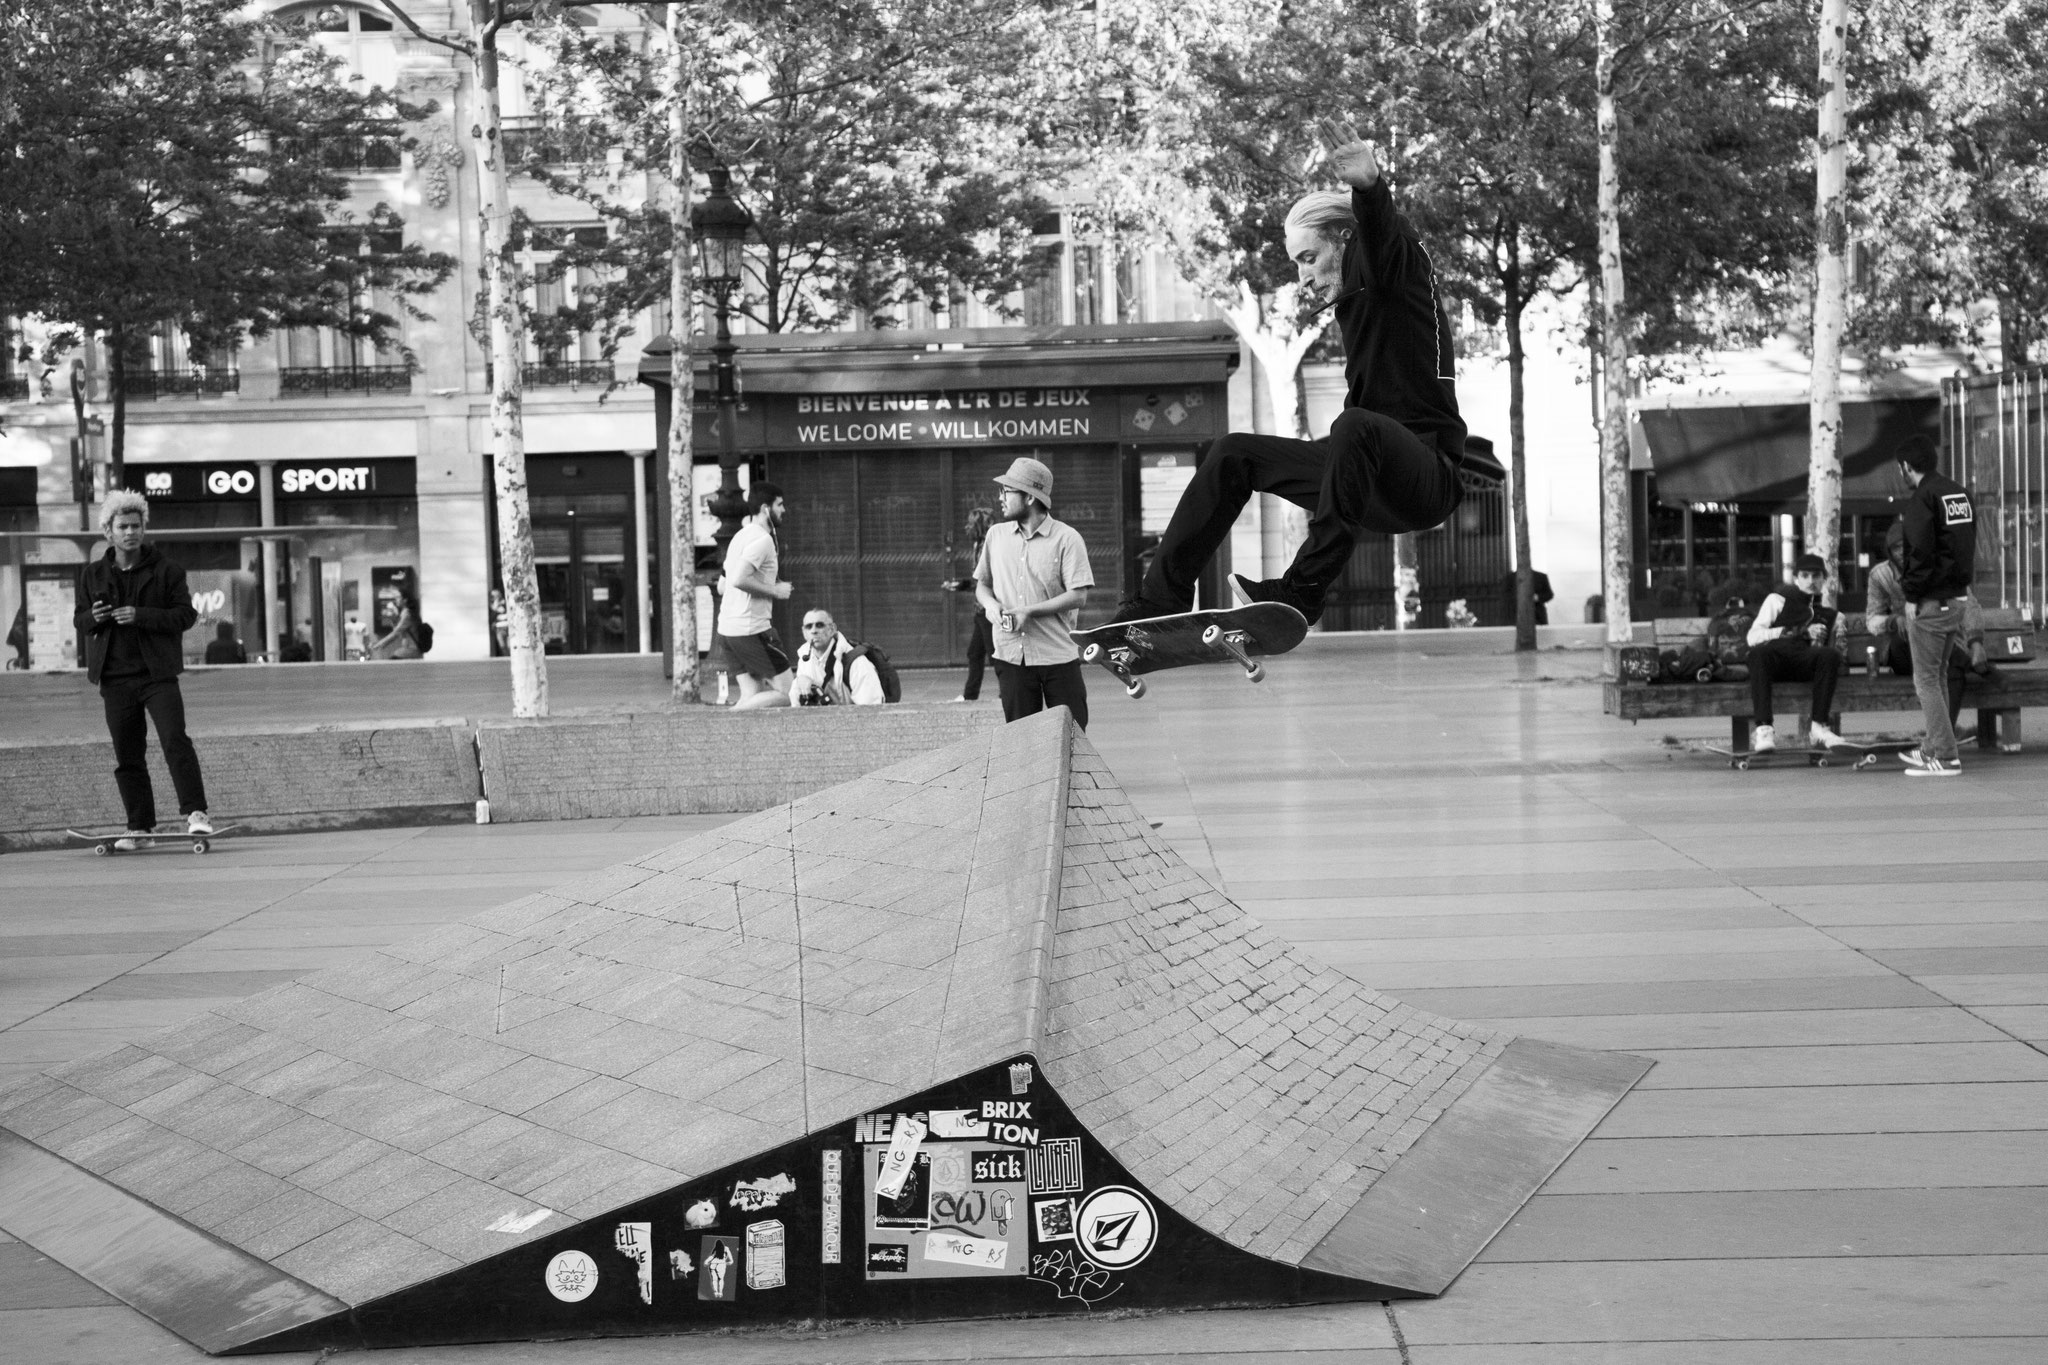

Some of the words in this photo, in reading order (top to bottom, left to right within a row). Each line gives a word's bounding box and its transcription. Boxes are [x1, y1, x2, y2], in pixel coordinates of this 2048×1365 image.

[798, 393, 929, 413] BIENVENUE
[998, 390, 1027, 408] DE
[1033, 388, 1090, 406] JEUX
[797, 421, 913, 443] WELCOME
[930, 417, 1090, 440] WILLKOMMEN
[145, 472, 172, 490] GO
[207, 469, 255, 494] GO
[281, 466, 369, 493] SPORT
[1948, 500, 1968, 518] obey
[982, 1100, 1032, 1119] BRIX
[992, 1122, 1040, 1146] TON
[974, 1153, 1022, 1180] sick
